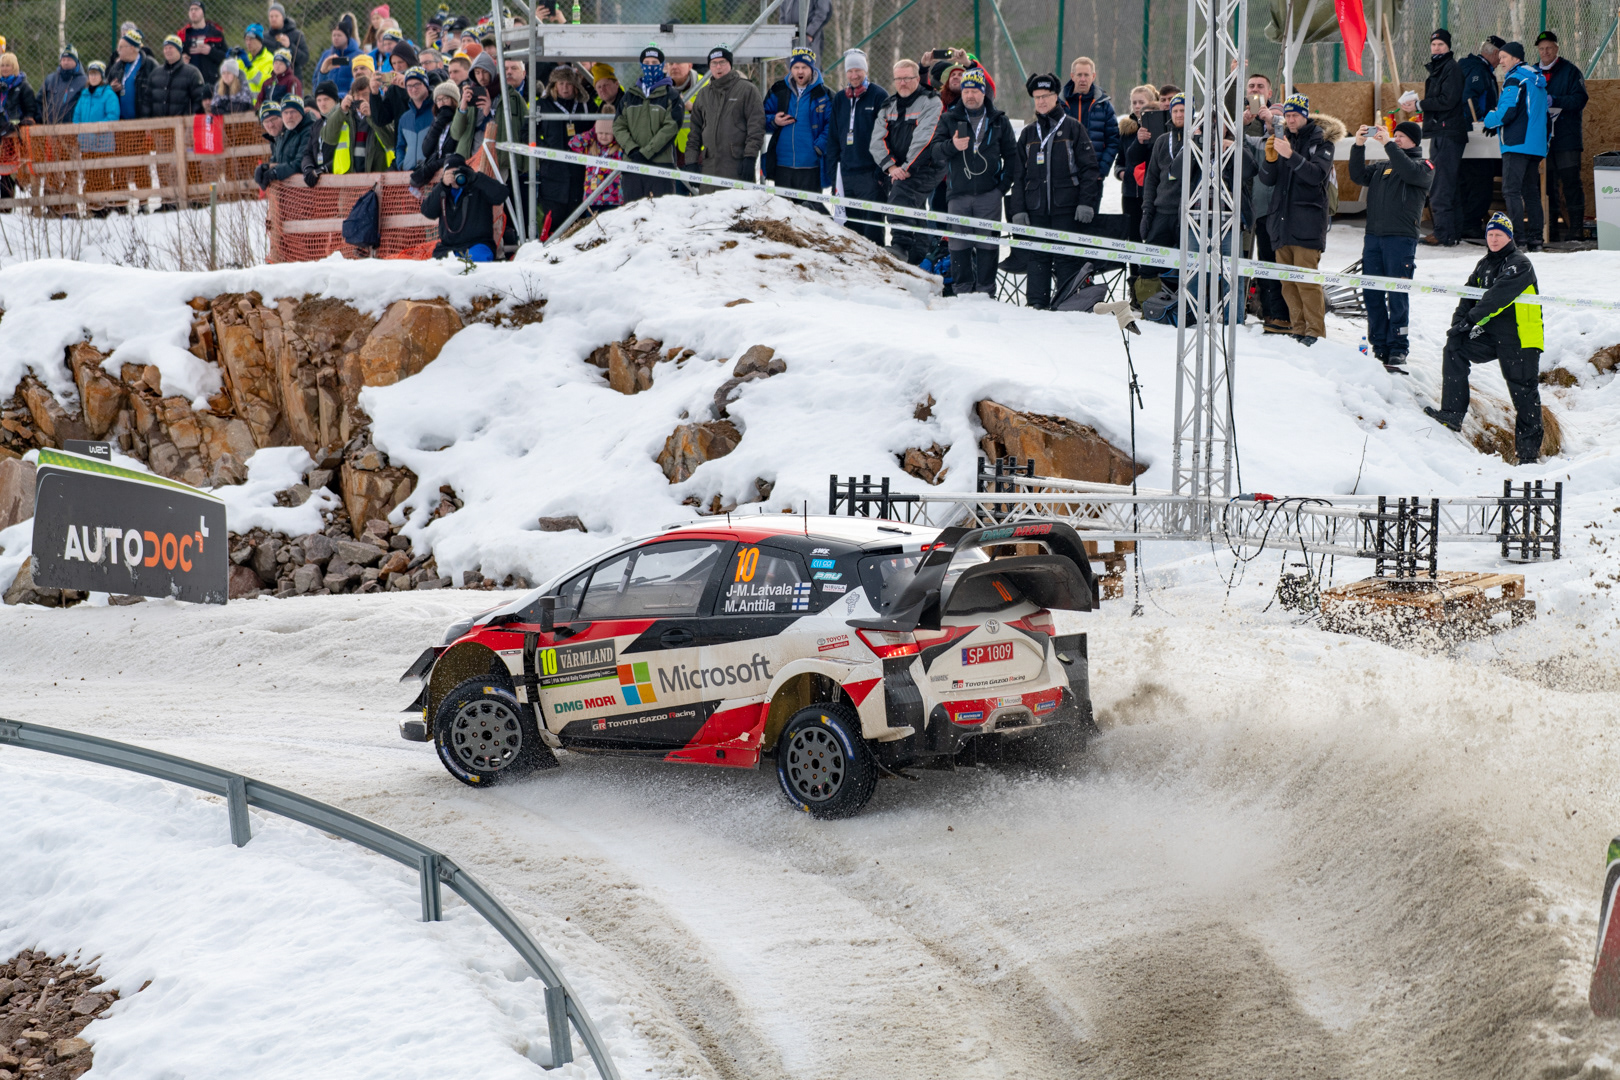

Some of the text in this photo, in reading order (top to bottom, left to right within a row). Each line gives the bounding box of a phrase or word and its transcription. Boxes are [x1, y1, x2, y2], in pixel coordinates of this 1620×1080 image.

[89, 445, 109, 455] WRC
[1013, 524, 1053, 537] MORI
[64, 524, 194, 572] AUTODOC
[735, 547, 760, 582] 10
[750, 583, 792, 598] Latvala
[992, 580, 1013, 602] 10
[738, 598, 775, 611] Anttila
[826, 634, 849, 643] TOYOTA
[540, 647, 614, 675] 10 VÄRMLAND
[969, 643, 1012, 663] SP 1009
[658, 653, 774, 693] Microsoft
[554, 695, 617, 714] DMG MORI
[1004, 696, 1022, 704] Microsoft
[607, 718, 638, 728] TOYOTA
[640, 713, 668, 724] GAZOO
[669, 710, 696, 719] Racing
